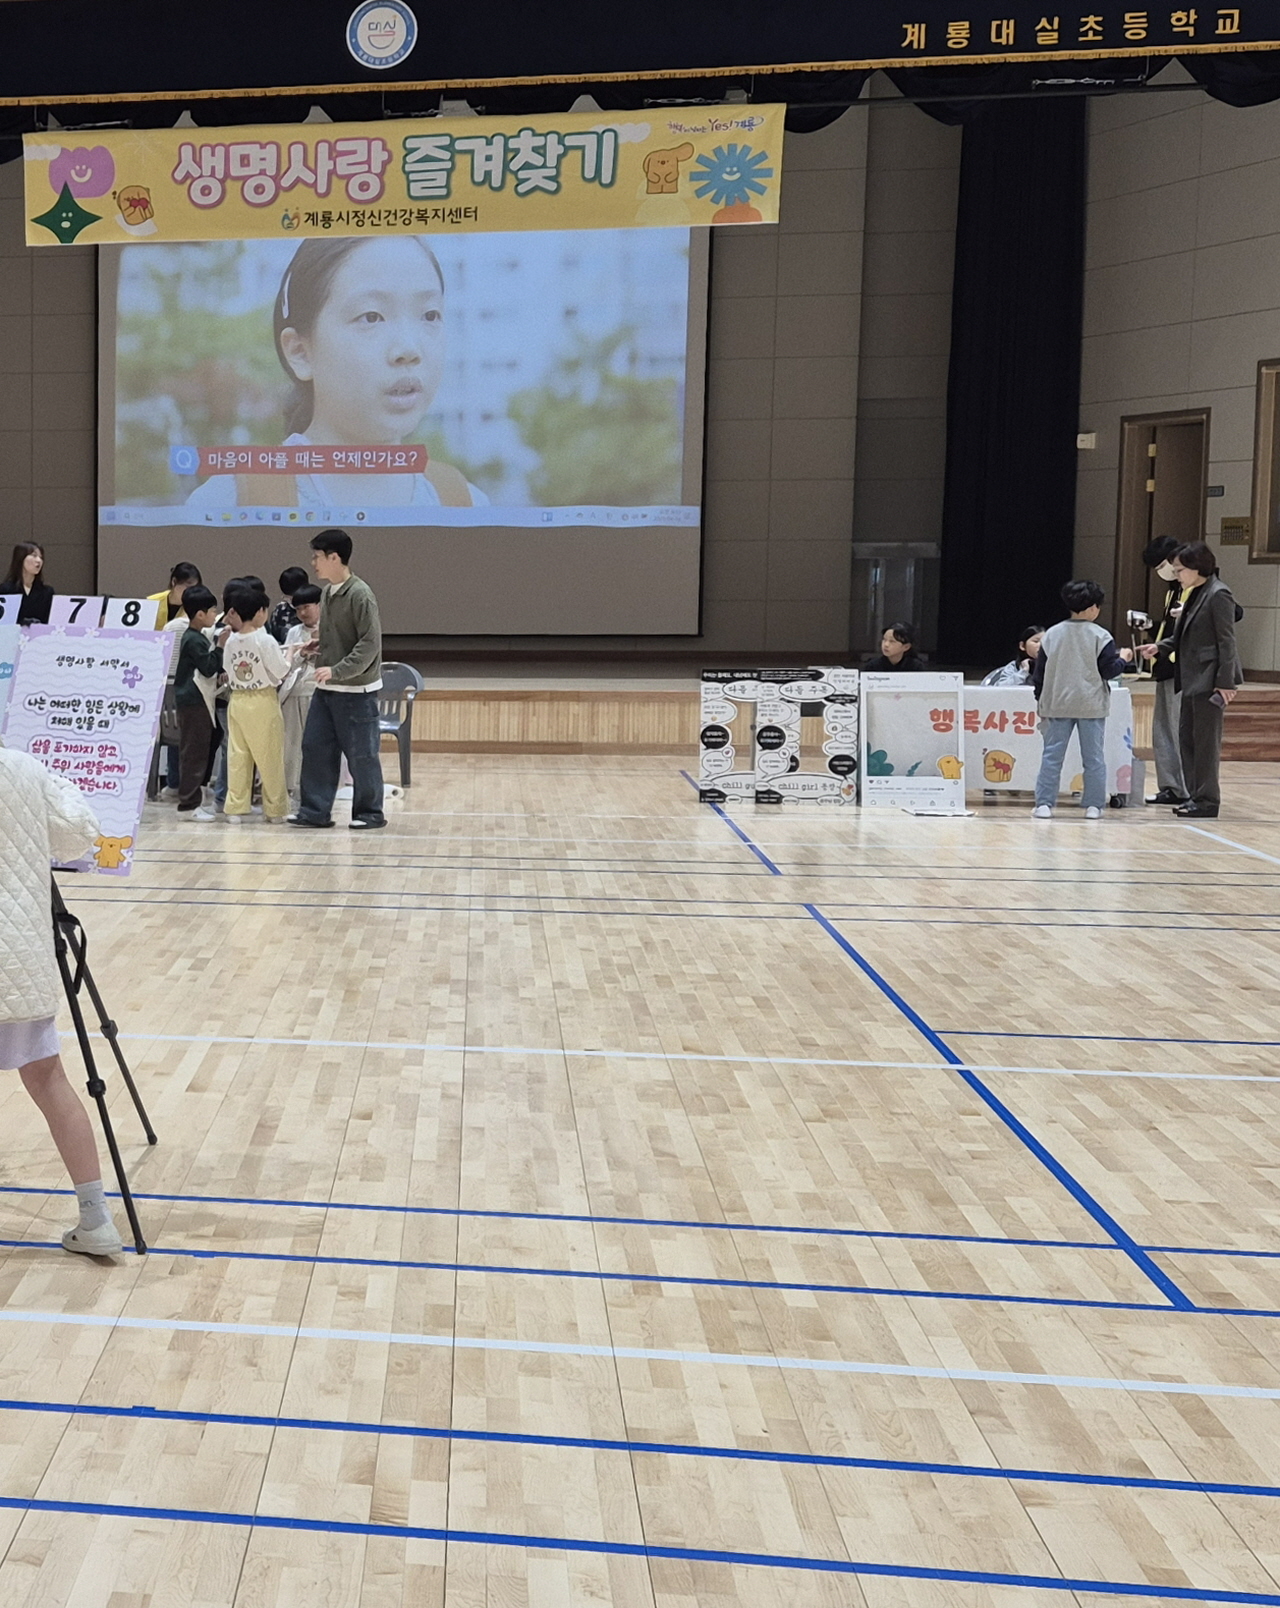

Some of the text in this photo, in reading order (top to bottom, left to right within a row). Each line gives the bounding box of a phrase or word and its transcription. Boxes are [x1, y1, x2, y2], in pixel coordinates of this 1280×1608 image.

[901, 9, 1241, 49] 계룡대실초등학교
[708, 118, 733, 131] Yes!
[173, 128, 619, 208] 생명사랑 즐겨찾기
[304, 206, 479, 229] 계룡시정신건강복지센터
[208, 450, 252, 469] 마음이
[259, 451, 289, 469] 아플
[295, 451, 325, 468] 때는
[332, 450, 418, 468] 언제인가요?
[69, 598, 87, 624] 7
[121, 600, 141, 627] 8
[56, 655, 130, 670] 생명사랑 서약서
[28, 696, 140, 716] 나는 어떠한 힘든 상황에
[51, 716, 110, 731] 처해 있을 때
[32, 739, 51, 755] 삶을
[54, 742, 94, 753] 포기하지
[74, 761, 126, 775] 사람들에게
[722, 781, 742, 789] chill
[778, 781, 799, 789] chill
[802, 782, 818, 791] girl
